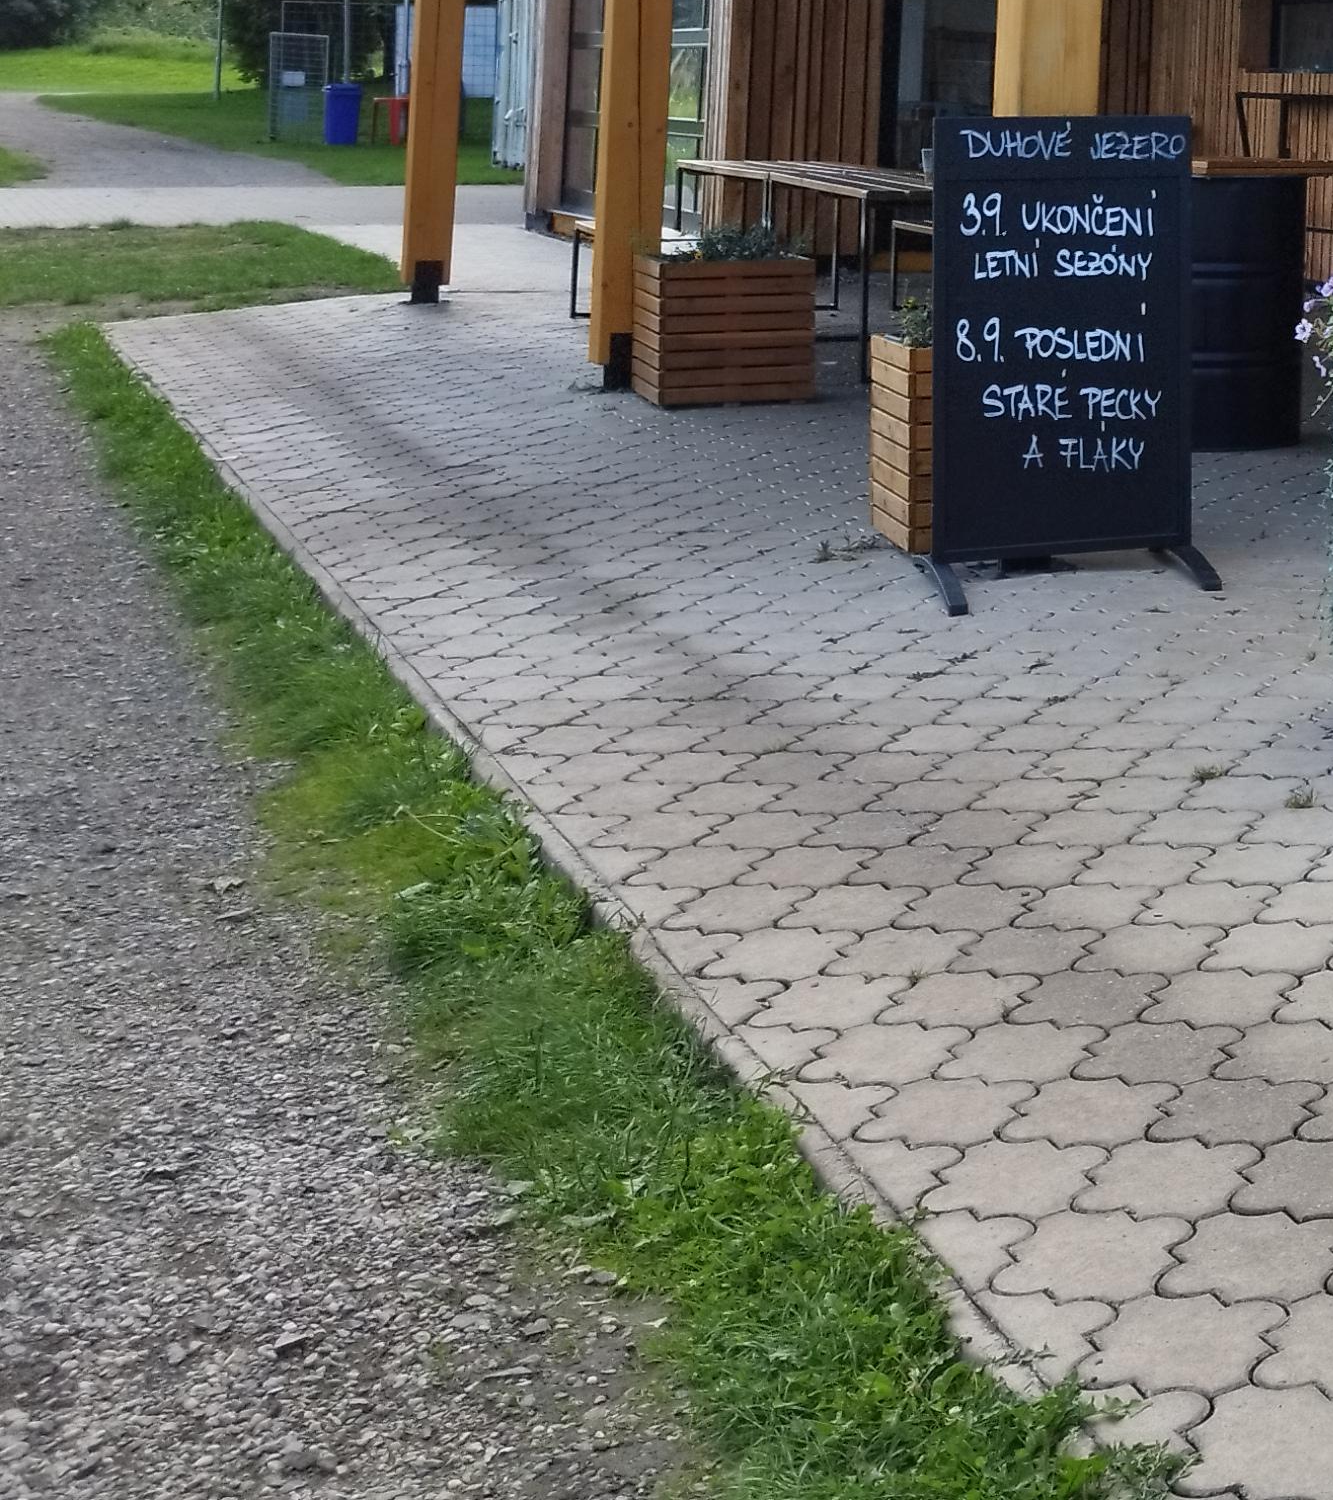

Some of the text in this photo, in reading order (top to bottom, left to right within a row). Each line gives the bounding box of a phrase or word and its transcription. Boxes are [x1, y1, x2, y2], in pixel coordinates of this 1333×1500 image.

[960, 121, 1187, 160] DUHOVÉ JEZERO
[1021, 189, 1157, 237] UKONČENÍ
[974, 238, 1152, 281] LETNÍ SEZÓNY
[956, 302, 1146, 363] 8.9. POSLEDNÍ
[982, 369, 1162, 423] STARÉ PECKY
[1022, 421, 1145, 473] A FLÁKY
